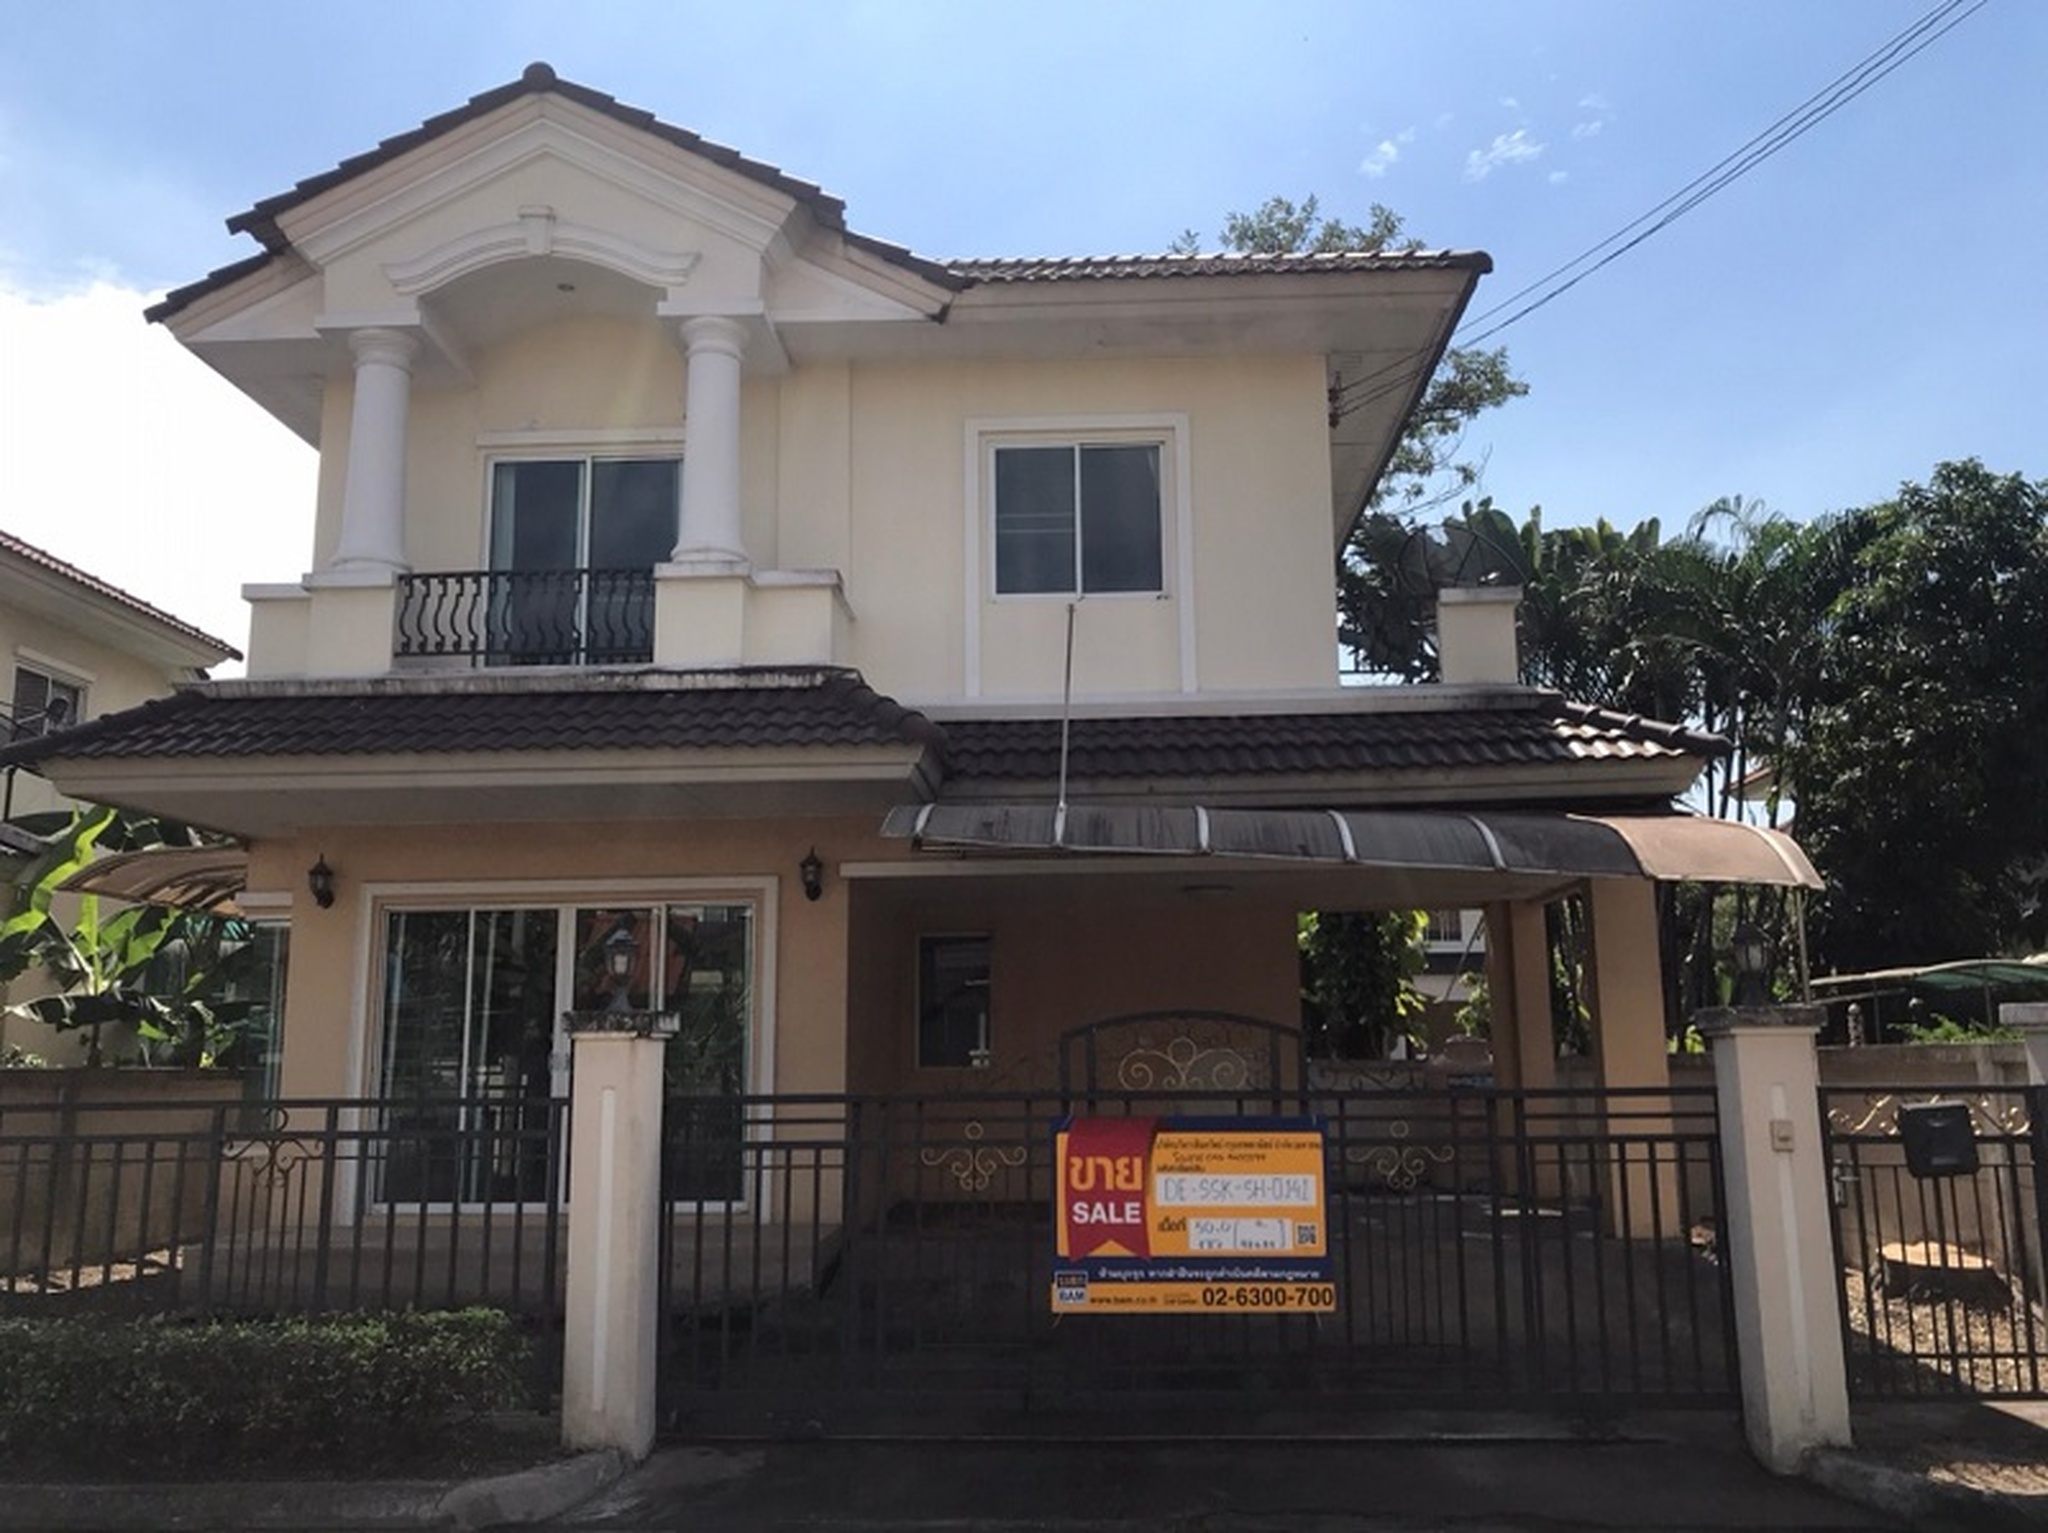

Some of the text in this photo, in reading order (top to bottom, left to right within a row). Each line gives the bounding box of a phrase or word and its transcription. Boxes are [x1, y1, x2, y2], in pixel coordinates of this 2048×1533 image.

[1070, 1156, 1142, 1191] ขาย
[1072, 1201, 1141, 1224] SALE
[1202, 1287, 1334, 1307] 02-6300-700
